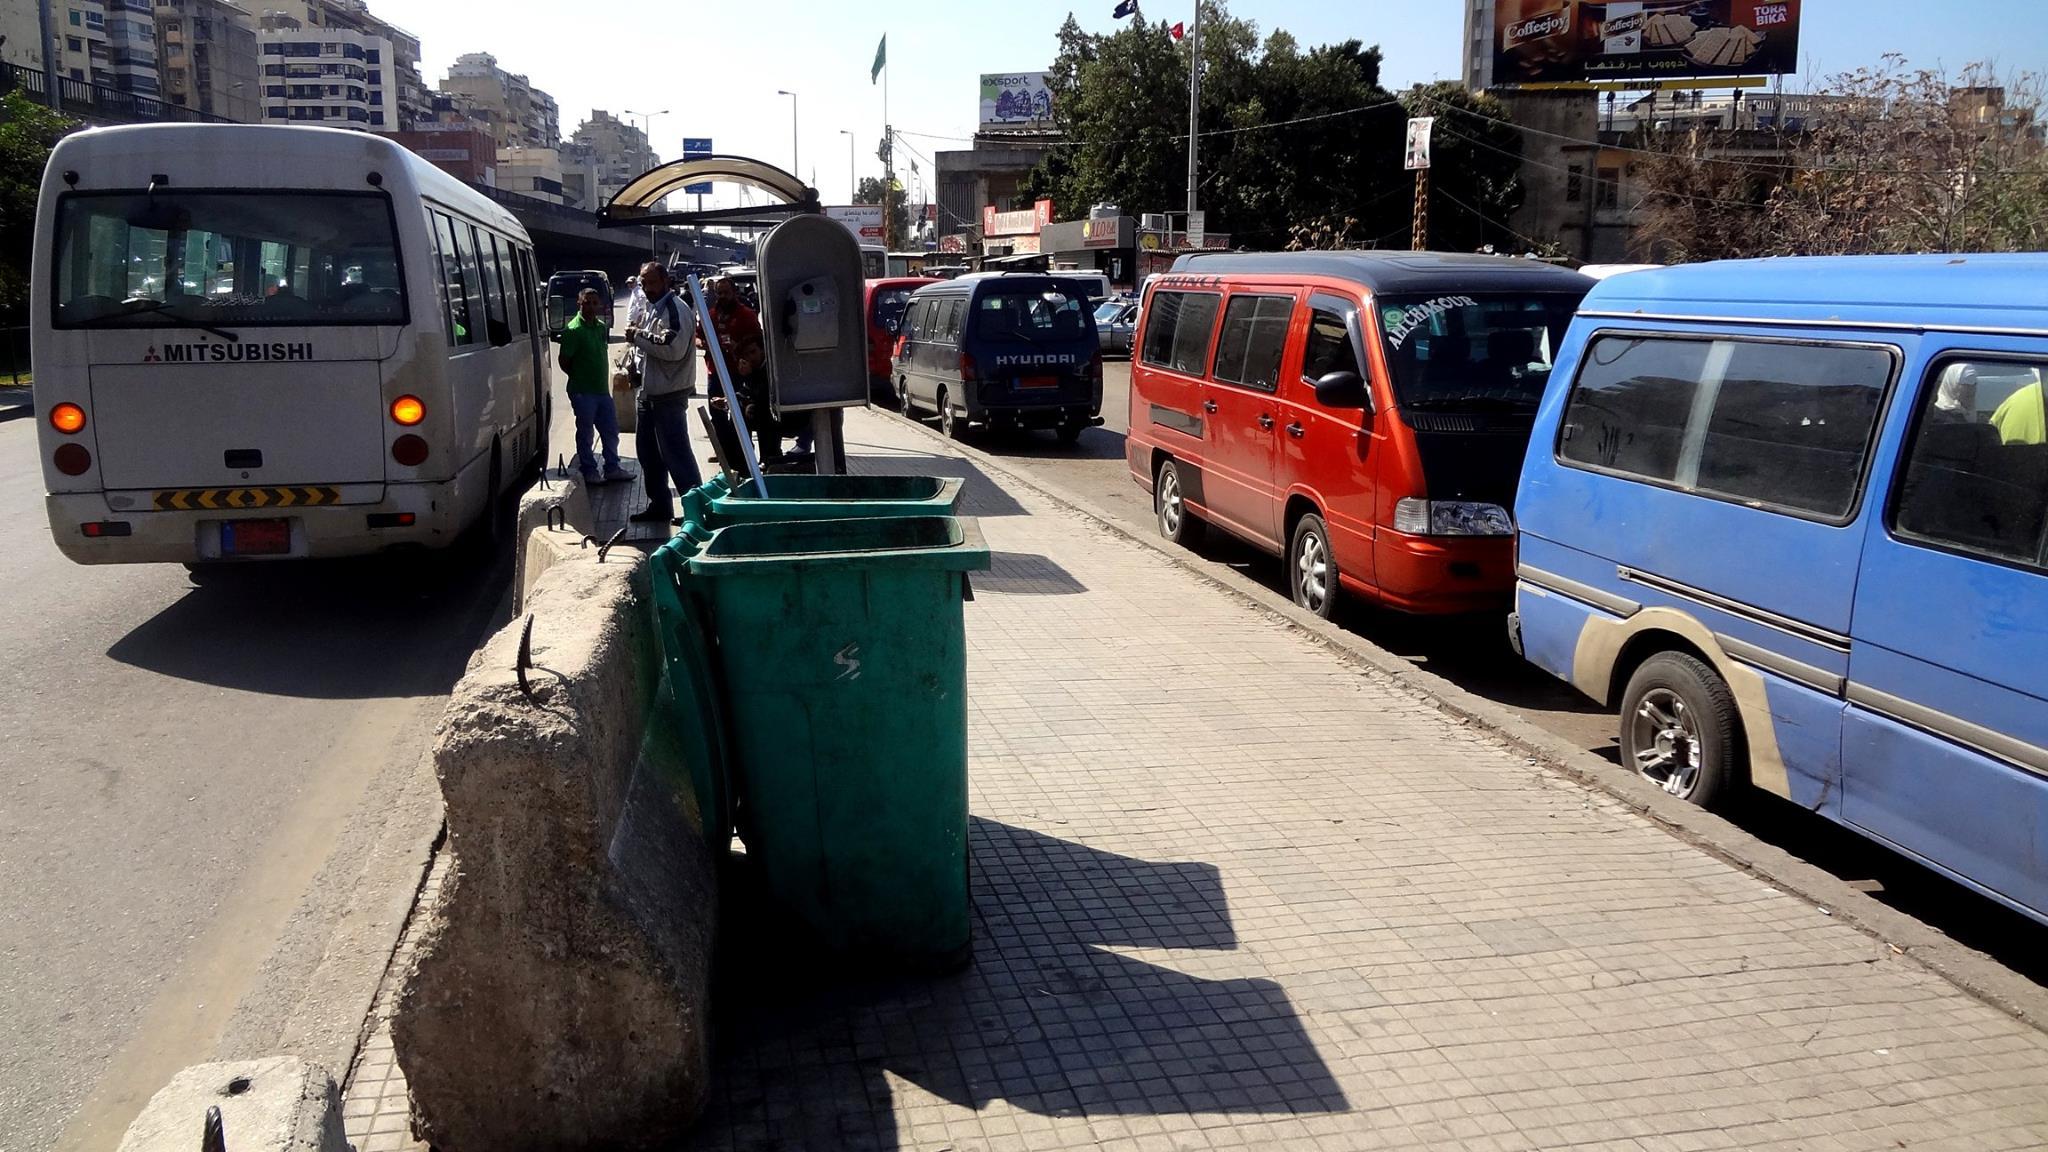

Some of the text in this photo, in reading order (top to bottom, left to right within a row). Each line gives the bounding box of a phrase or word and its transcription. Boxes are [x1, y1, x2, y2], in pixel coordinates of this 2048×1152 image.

[1753, 5, 1787, 15] TORA
[1756, 13, 1786, 26] BIKA
[1507, 16, 1568, 39] Coffeejoy
[1603, 17, 1644, 34] Coffeejoy
[983, 76, 1028, 87] exsport
[1624, 81, 1662, 90] PIKASSO
[1161, 276, 1222, 287] PRINCE
[163, 343, 313, 362] MITSUBISHI
[996, 354, 1075, 365] HYUNDAI
